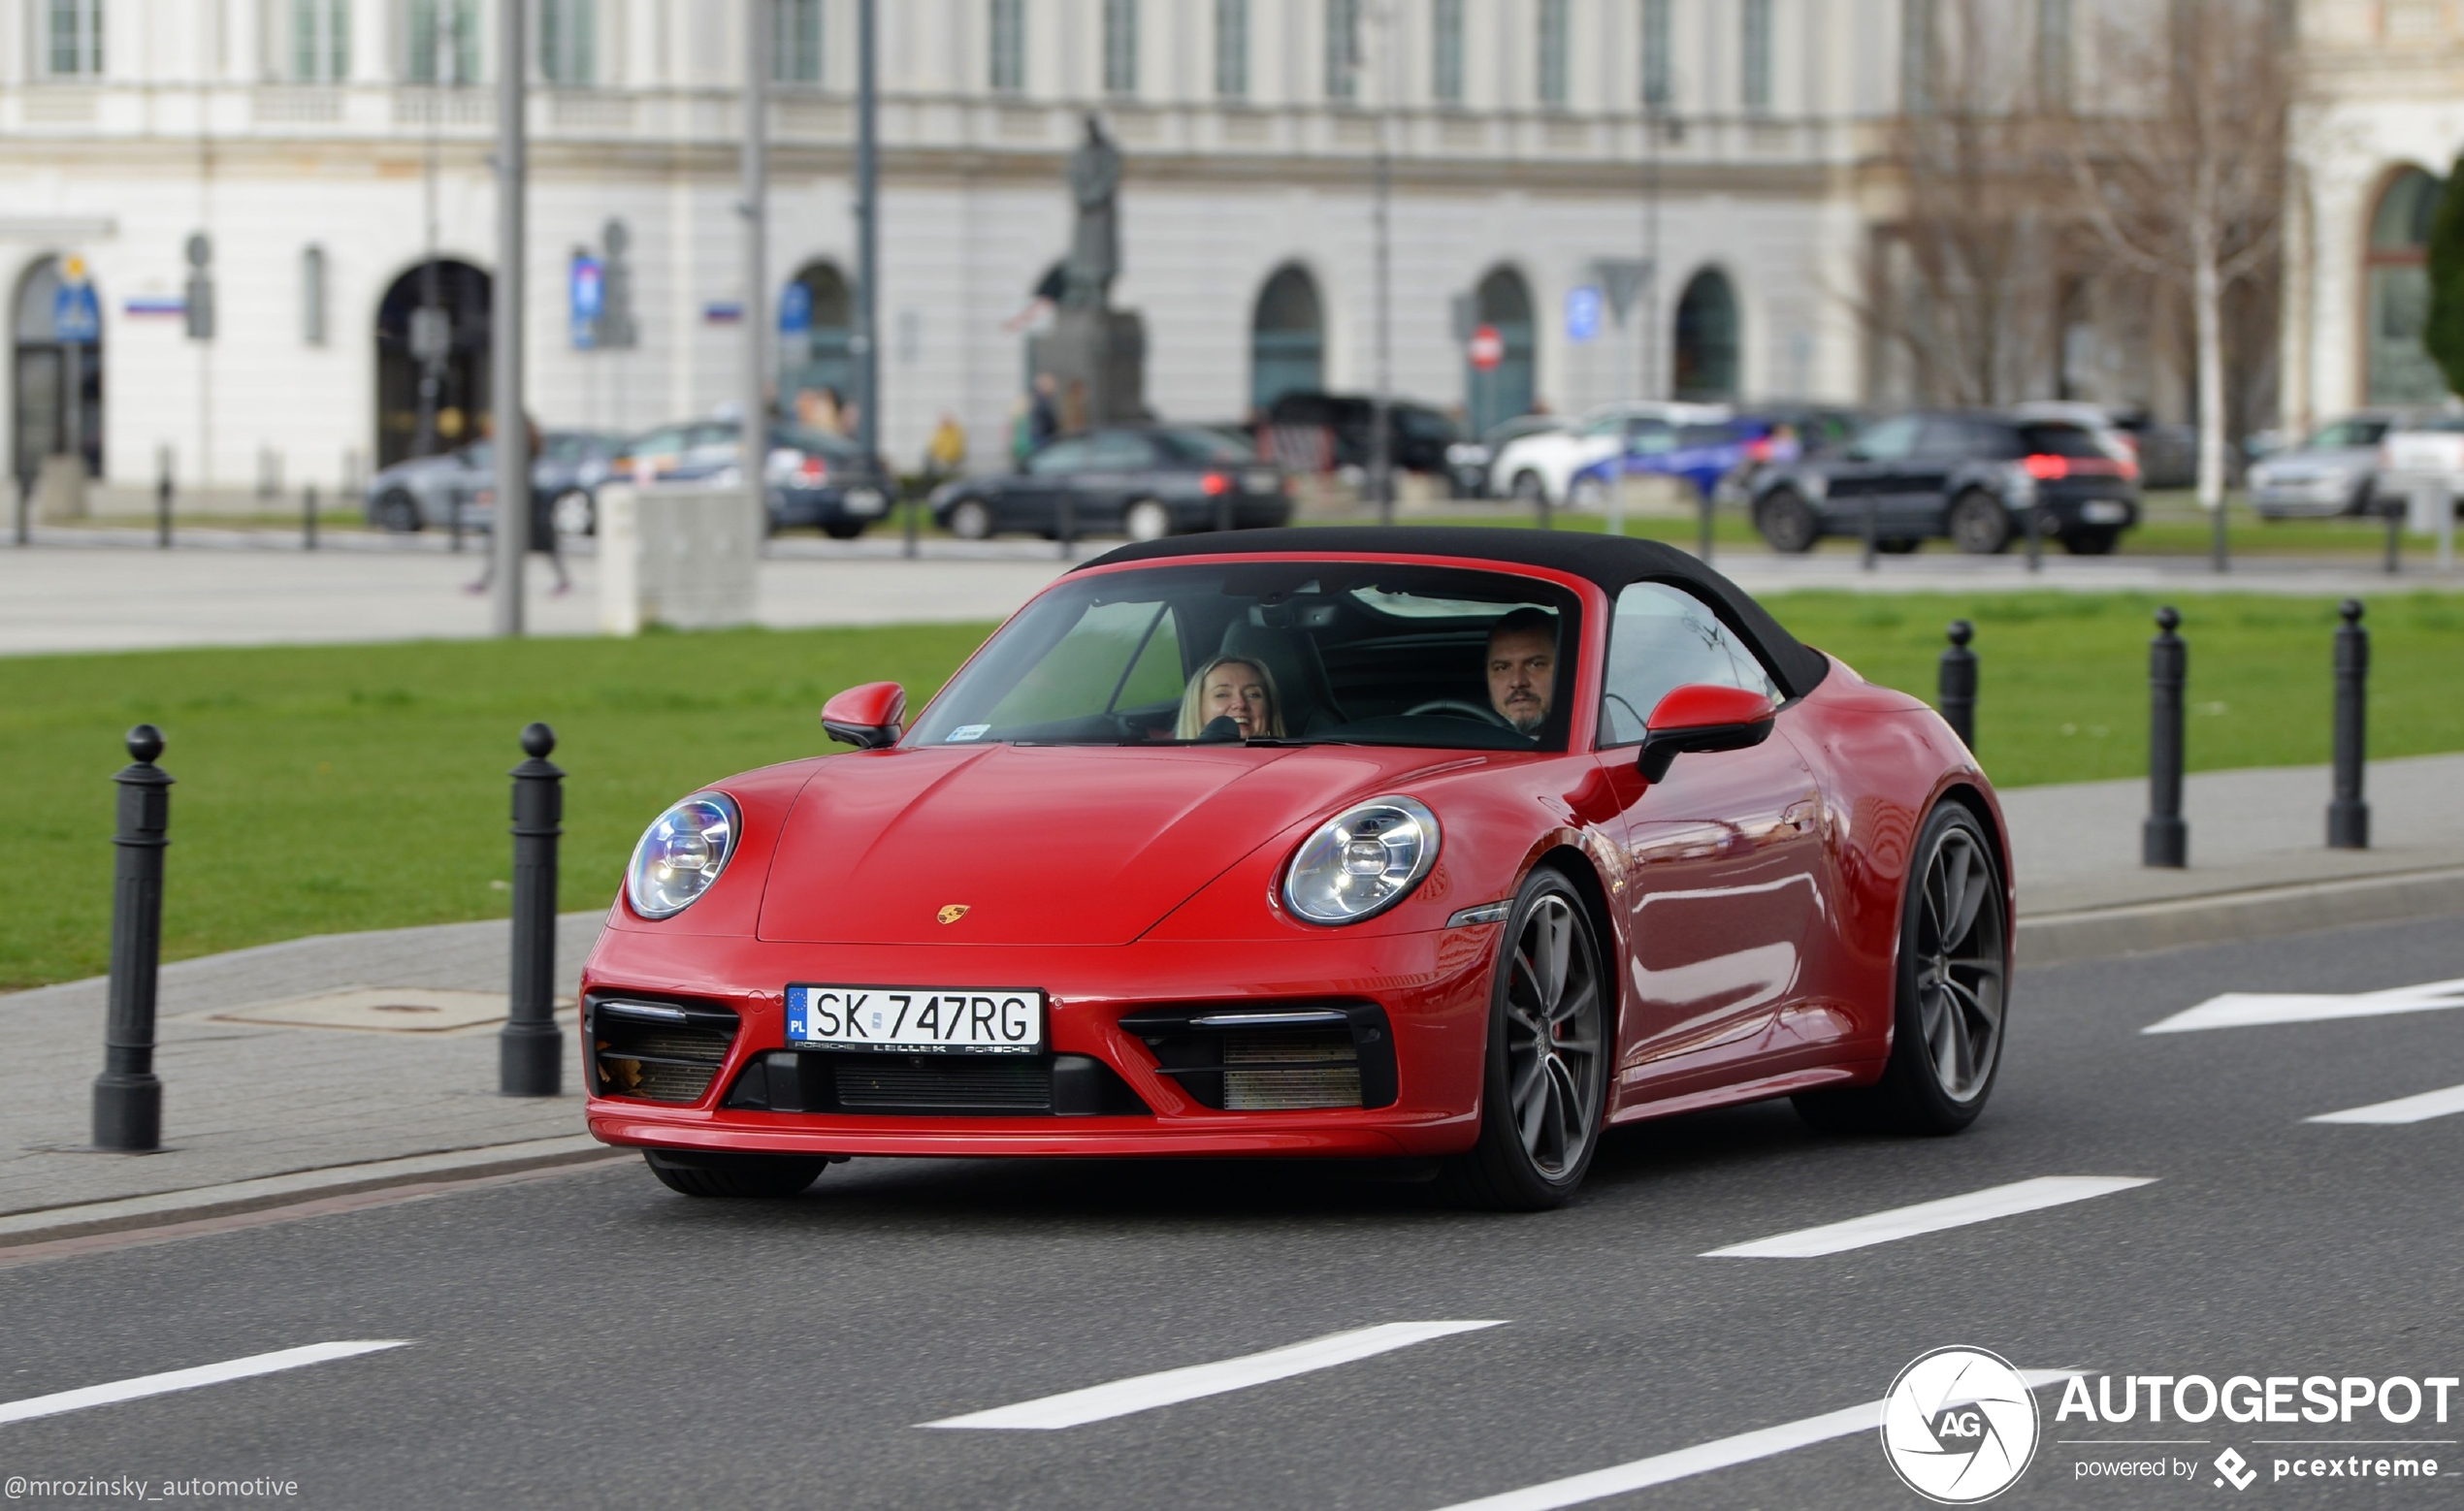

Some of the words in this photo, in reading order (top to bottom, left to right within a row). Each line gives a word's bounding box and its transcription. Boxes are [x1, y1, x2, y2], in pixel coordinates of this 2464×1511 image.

[817, 993, 869, 1038] SK
[889, 995, 1026, 1041] 747RG
[791, 1020, 805, 1033] PL
[794, 1042, 856, 1050] PORSCHE
